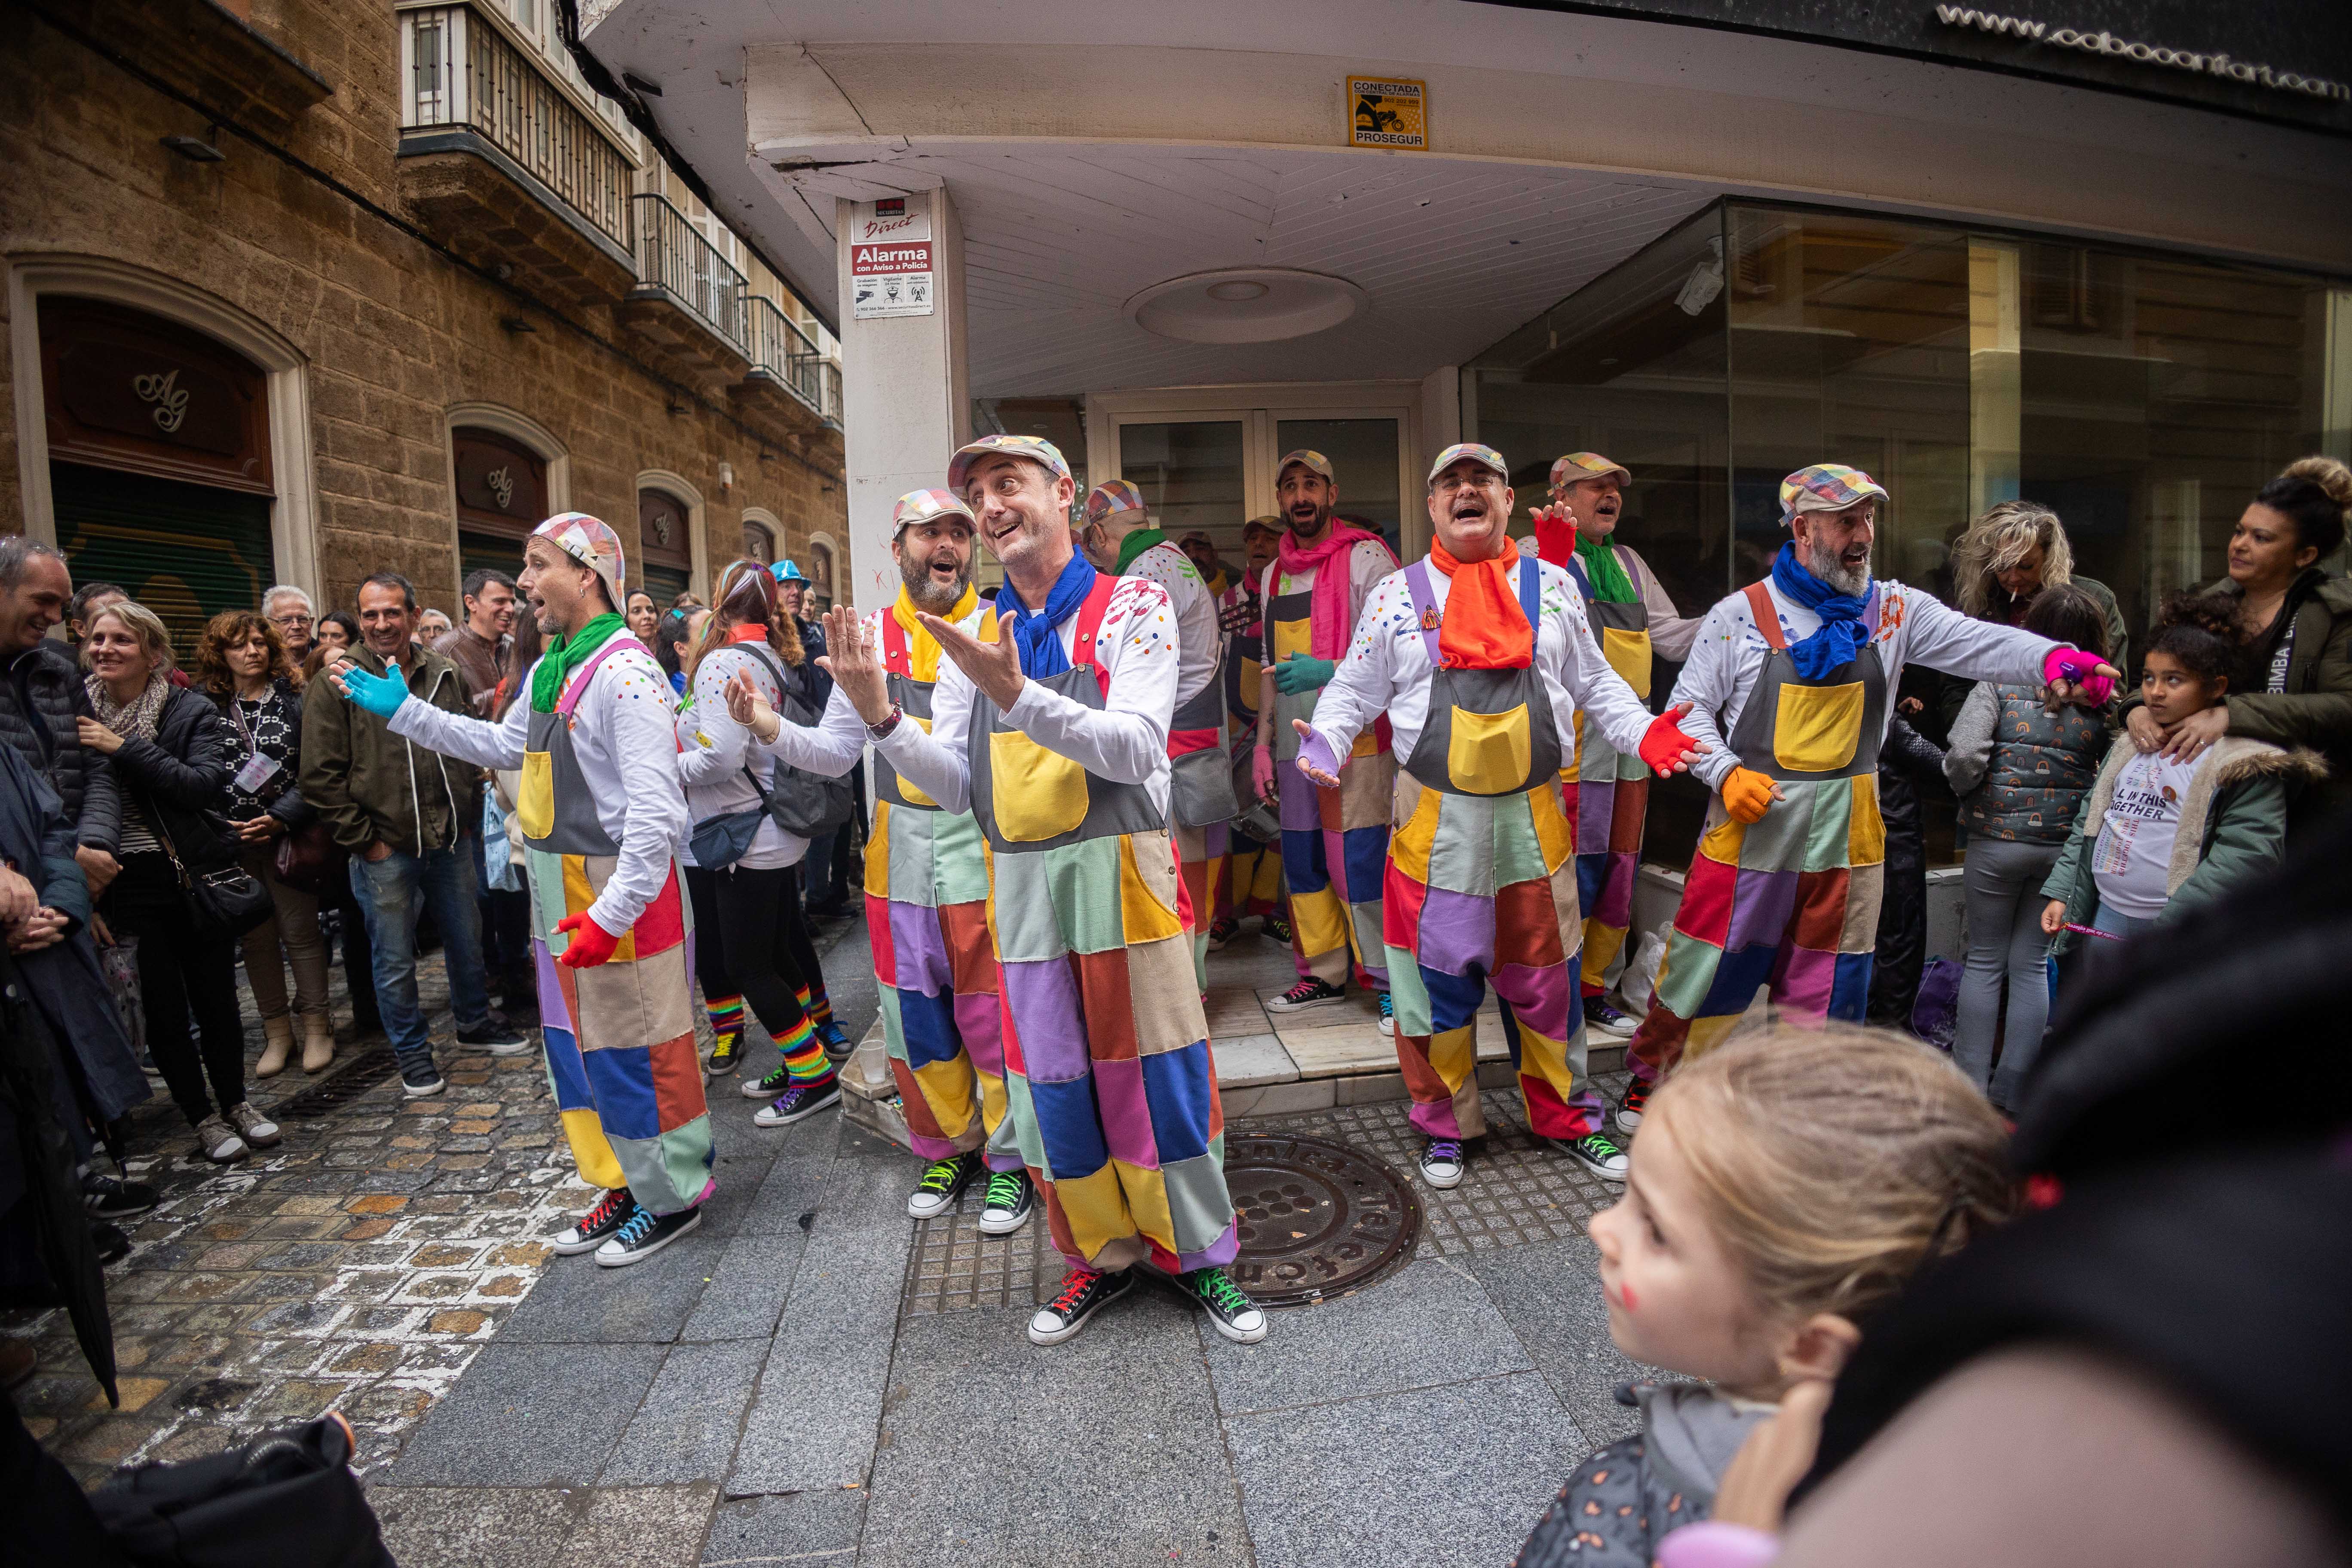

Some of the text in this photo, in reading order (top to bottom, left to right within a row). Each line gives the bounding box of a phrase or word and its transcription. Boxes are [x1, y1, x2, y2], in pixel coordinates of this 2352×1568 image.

[1354, 82, 1420, 93] CONECTADA
[1357, 132, 1422, 145] PROSEGUR
[864, 213, 919, 238] Direct
[857, 247, 927, 263] Alarma
[2127, 791, 2138, 800] IN
[2139, 793, 2167, 808] THIS
[2110, 800, 2164, 820] OGETHER
[2118, 840, 2133, 877] TOGETHER
